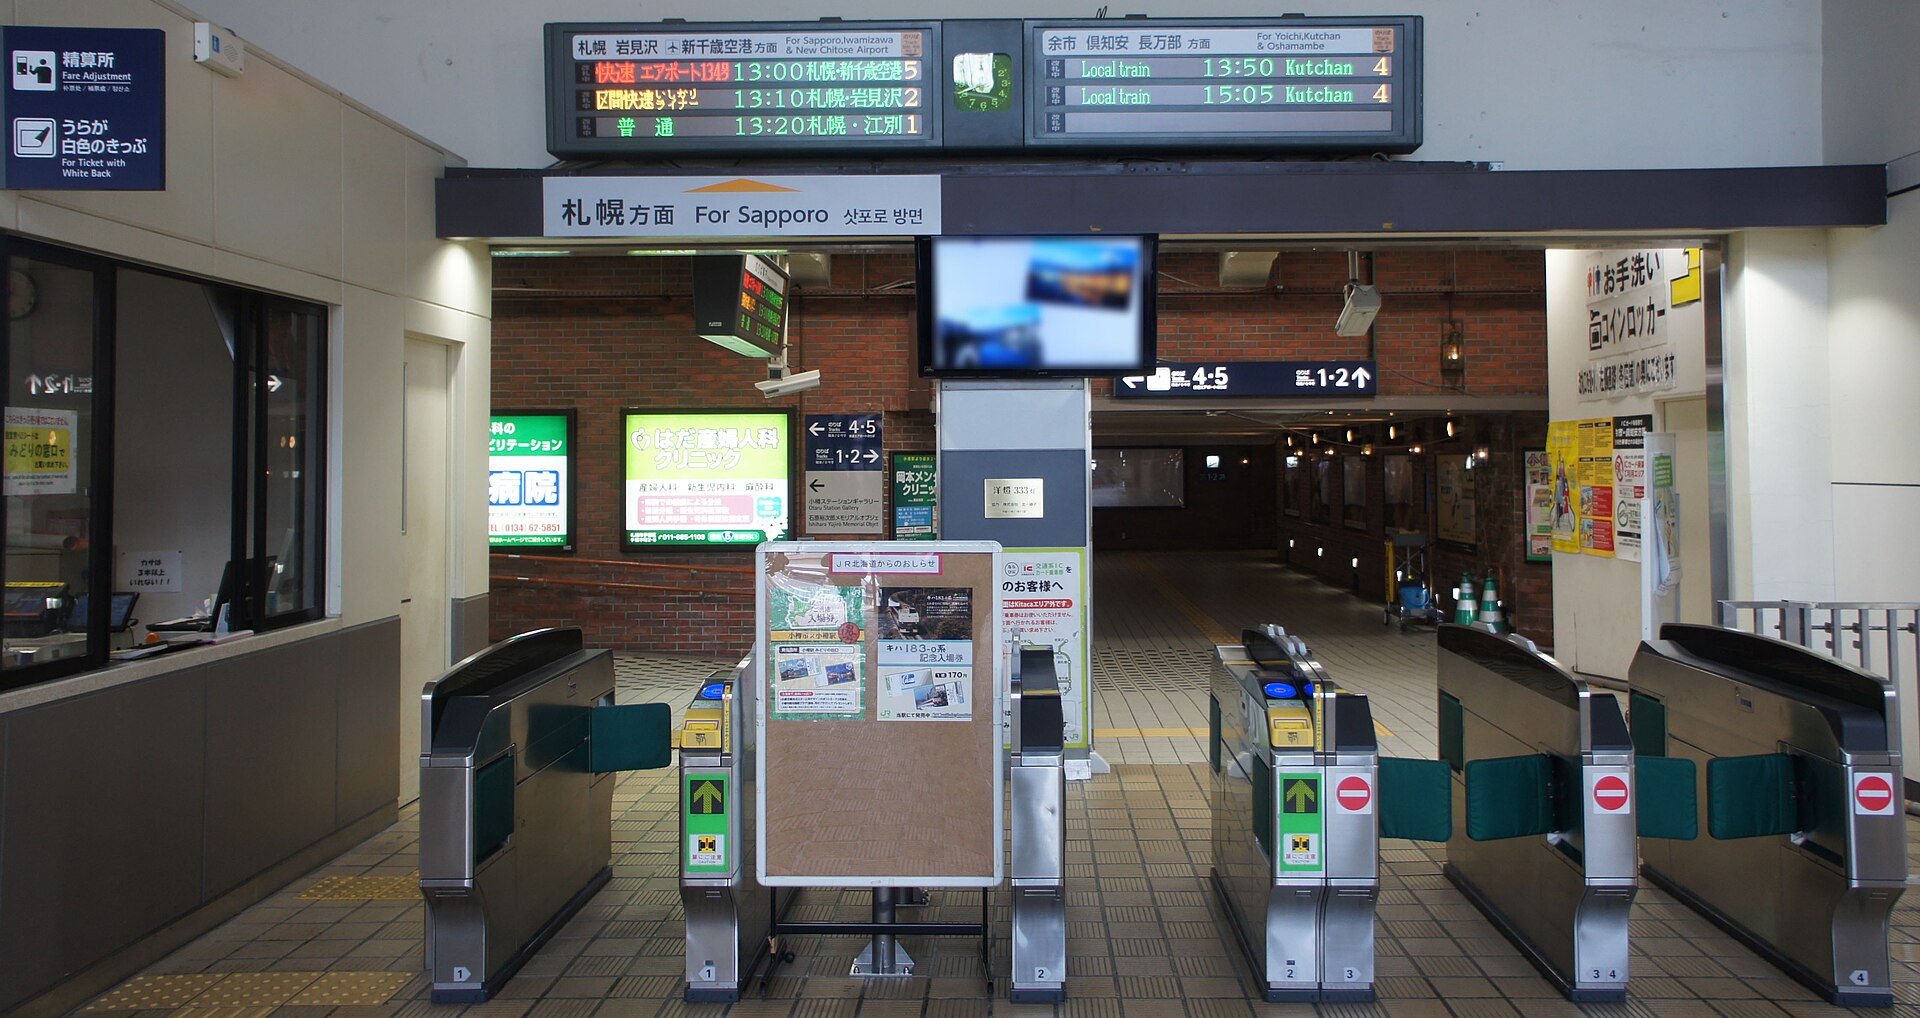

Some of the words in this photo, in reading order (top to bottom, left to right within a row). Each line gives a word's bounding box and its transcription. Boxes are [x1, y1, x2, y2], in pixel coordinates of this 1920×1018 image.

[786, 36, 800, 44] For
[1048, 35, 1076, 50] 余市
[1086, 35, 1129, 50] 倶知安
[1138, 35, 1181, 50] 長万部
[1188, 38, 1210, 49] 方面
[578, 40, 606, 55] 札幌
[616, 40, 658, 55] 岩見沢
[819, 46, 854, 54] Chitose
[857, 46, 888, 56] Airport
[1257, 42, 1264, 50] &
[1267, 42, 1325, 50] Oshamambe
[63, 52, 114, 68] 精算所
[595, 61, 636, 83] 快速
[640, 61, 730, 82] エアポート134号
[734, 62, 804, 81] 13:00
[806, 61, 902, 81] 札幌・新千歳空港
[904, 61, 918, 80] 5
[1082, 60, 1116, 78] Local
[1118, 61, 1151, 78] train
[1203, 58, 1273, 77] 13:50
[1286, 59, 1353, 76] Kutchan
[1372, 57, 1389, 76] 4
[62, 72, 80, 80] Fare
[83, 72, 131, 82] Adjustment
[596, 90, 654, 110] 区間快速
[735, 90, 804, 108] 13:10
[807, 88, 902, 108] 札幌・岩見沢
[904, 88, 918, 107] 2
[1082, 87, 1116, 105] Local
[1118, 88, 1151, 105] train
[1203, 85, 1273, 104] 15:05
[1286, 86, 1353, 103] Kutchan
[1372, 84, 1389, 103] 4
[62, 120, 108, 135] うらが
[736, 116, 805, 135] 13:20
[806, 115, 902, 135] 札幌・江別
[907, 115, 917, 134] 1
[62, 138, 147, 154] 白色のきっぷ
[62, 159, 76, 167] For
[78, 158, 104, 167] Ticket
[107, 158, 126, 167] with
[62, 169, 88, 177] White
[91, 169, 111, 177] Back
[695, 206, 730, 223] For
[738, 206, 829, 229] Sapporo
[843, 208, 888, 225] 삿포로
[893, 207, 923, 225] 방면
[1604, 251, 1660, 295] お手洗い
[1602, 296, 1665, 344] コインロッカー
[489, 422, 515, 435] 科の
[654, 427, 779, 450] はだ産婦人科
[9, 444, 65, 458] みどりの窓口で
[654, 449, 741, 470] クリニック
[489, 471, 559, 505] 病院
[639, 483, 677, 492] 産婦人科
[687, 483, 735, 492] 新生児内科
[746, 483, 774, 492] 麻酔科
[528, 523, 561, 533] 62-5851
[836, 560, 936, 568] JR北海道からのおしらせ
[1065, 566, 1072, 574] を
[1002, 580, 1064, 592] のお客様へ
[920, 654, 964, 662] 記念入場券
[457, 969, 463, 978] 1
[705, 968, 711, 978] 1
[1037, 969, 1044, 978] 2
[1286, 969, 1294, 978] 2
[1346, 969, 1354, 979] 3
[1592, 969, 1600, 979] 3
[1609, 969, 1616, 979] 4
[1856, 972, 1864, 982] 4
